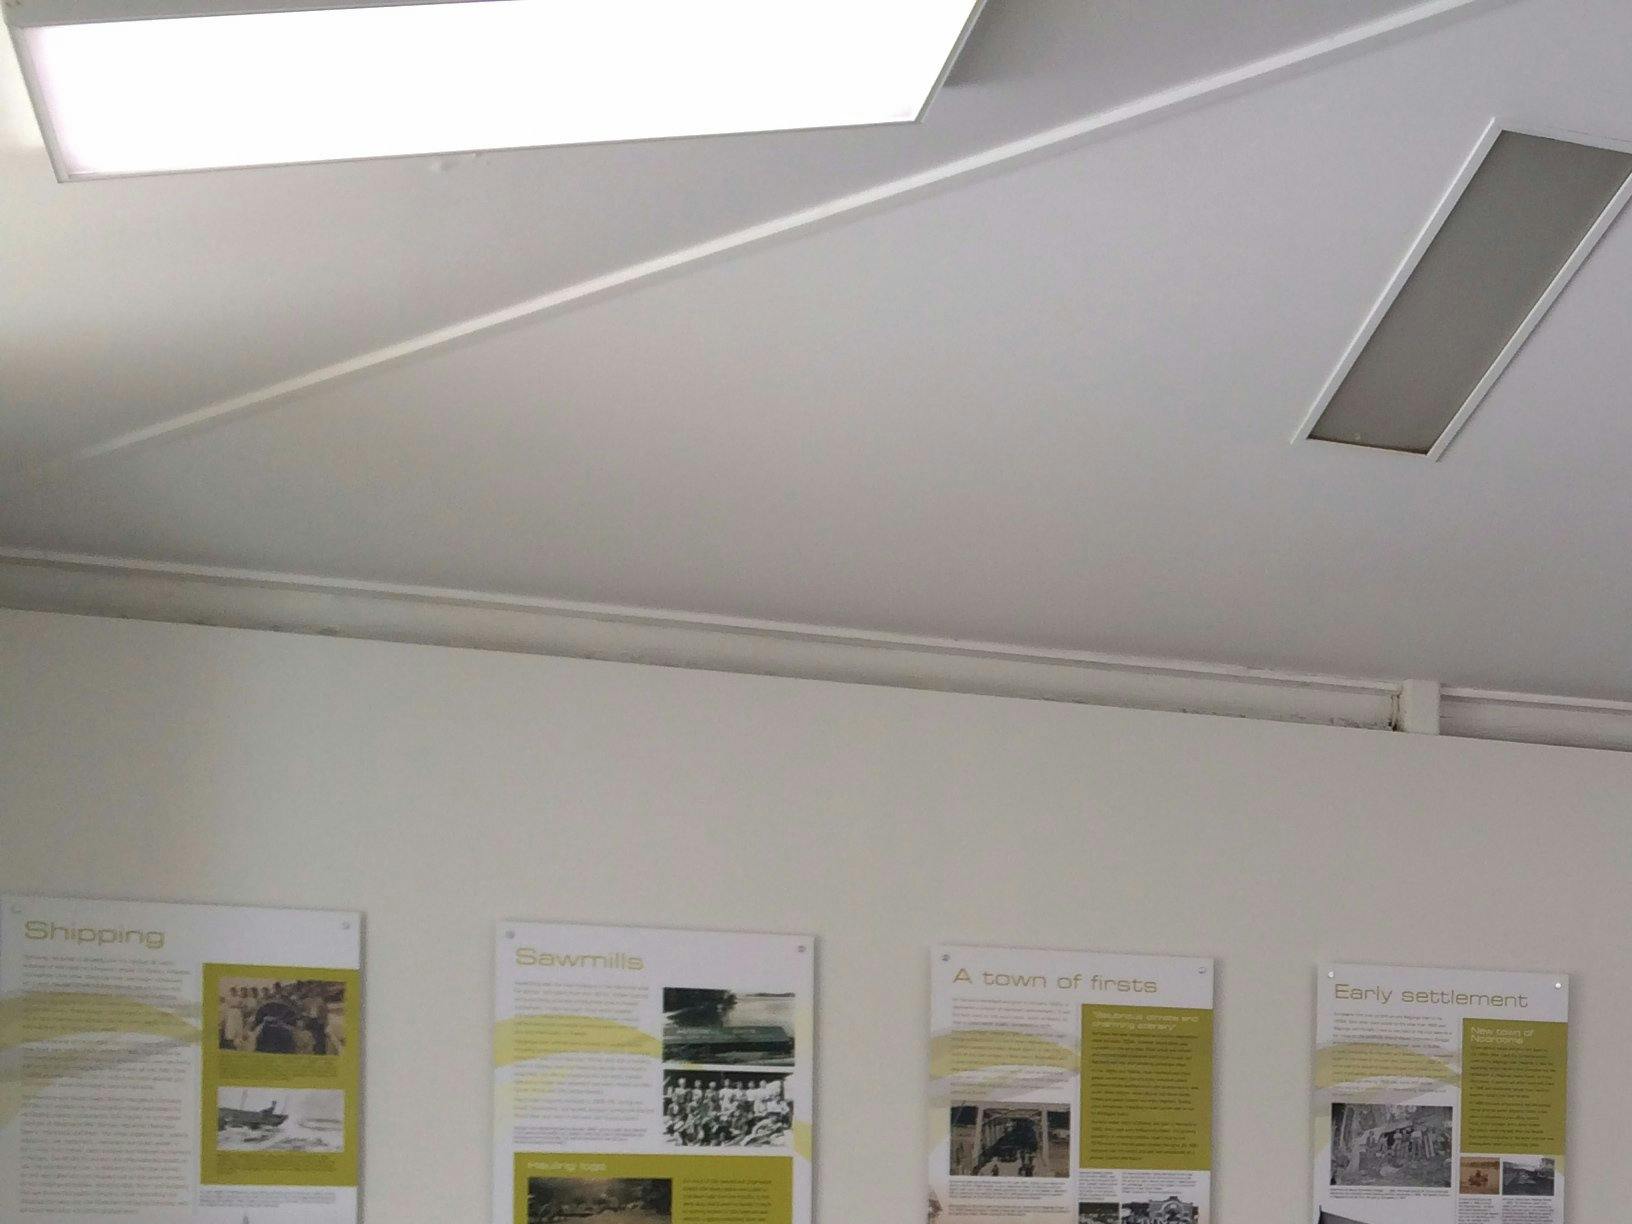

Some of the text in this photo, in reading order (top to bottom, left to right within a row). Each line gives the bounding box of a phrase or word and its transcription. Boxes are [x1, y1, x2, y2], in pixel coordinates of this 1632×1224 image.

[24, 920, 166, 949] Shipping
[515, 947, 644, 971] Sawmills
[953, 967, 1158, 993] A town of firsts
[1334, 983, 1528, 1008] Early settlement
